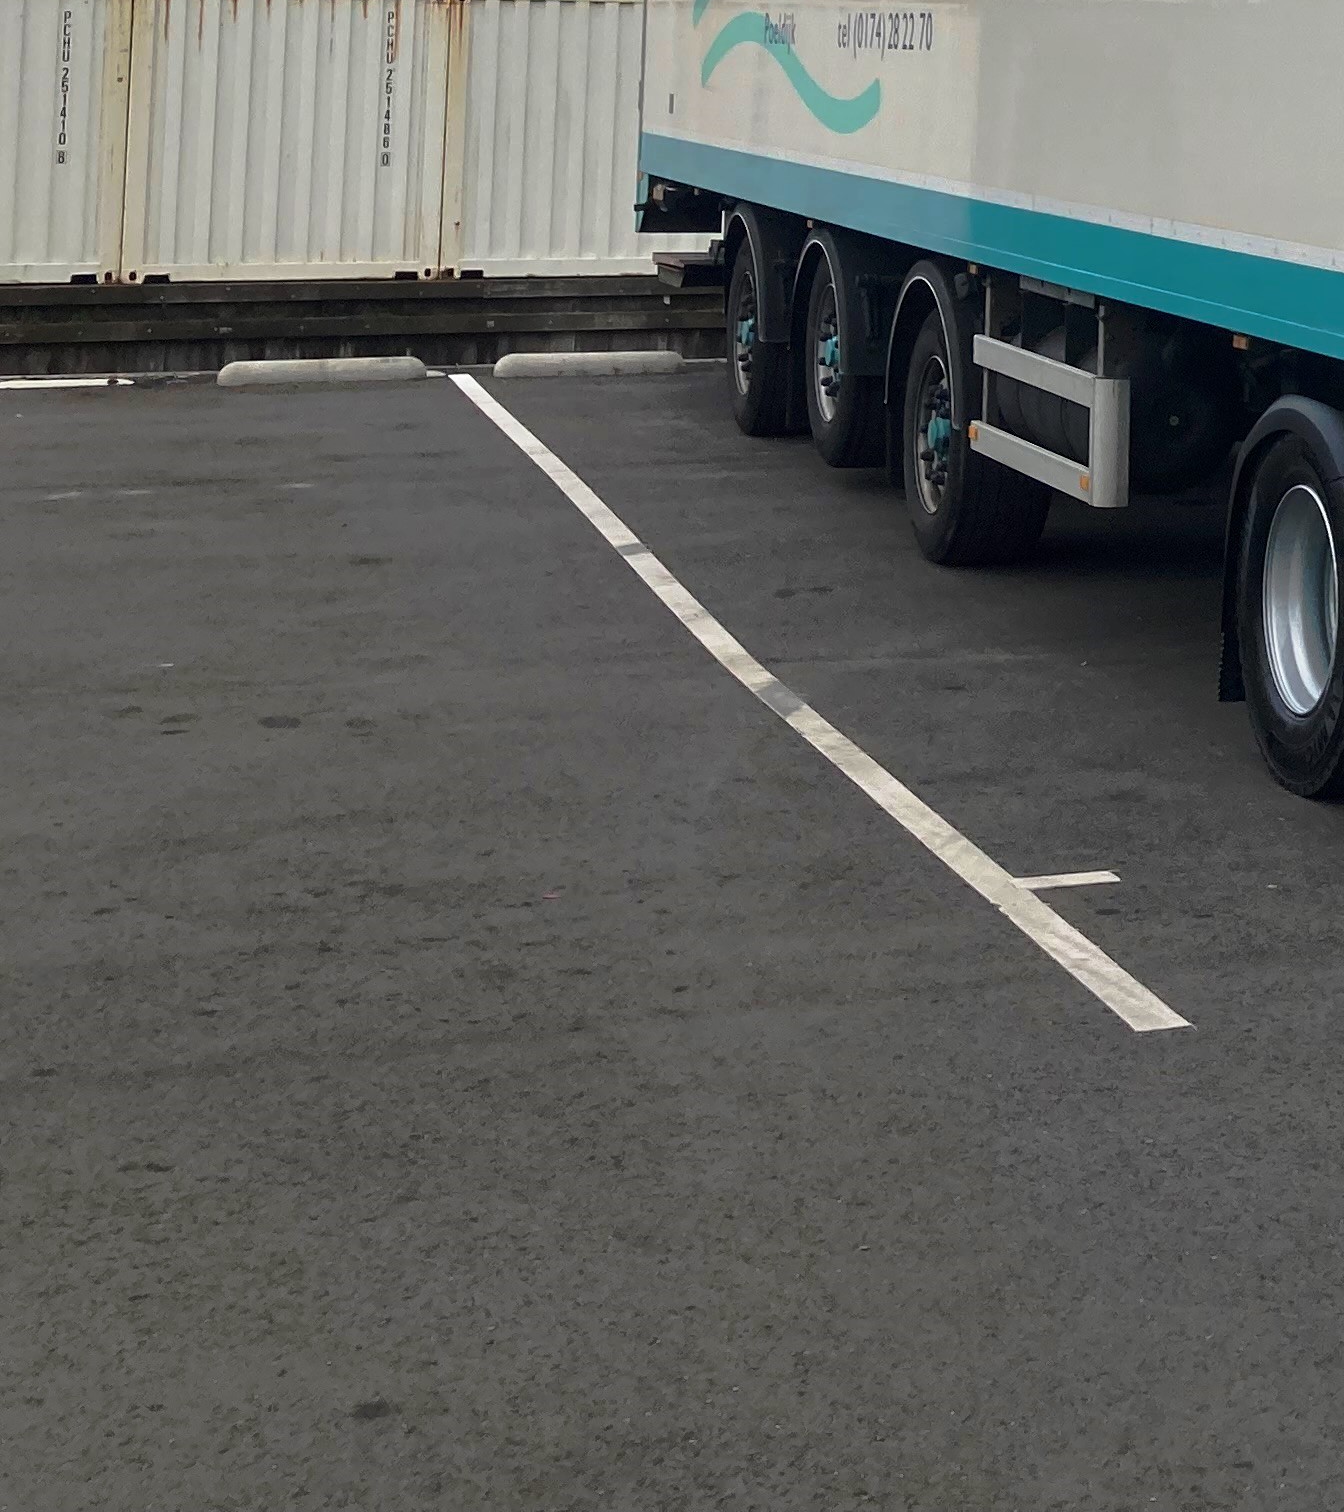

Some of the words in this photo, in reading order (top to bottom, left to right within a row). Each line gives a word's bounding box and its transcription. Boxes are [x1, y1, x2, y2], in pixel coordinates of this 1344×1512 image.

[62, 11, 72, 62] PCHU
[386, 11, 395, 64] PCHU
[838, 13, 850, 48] tel
[853, 12, 886, 61] (0174)
[888, 12, 900, 49] 28
[902, 12, 915, 50] 22
[920, 12, 933, 51] 70
[58, 67, 69, 145] 251410
